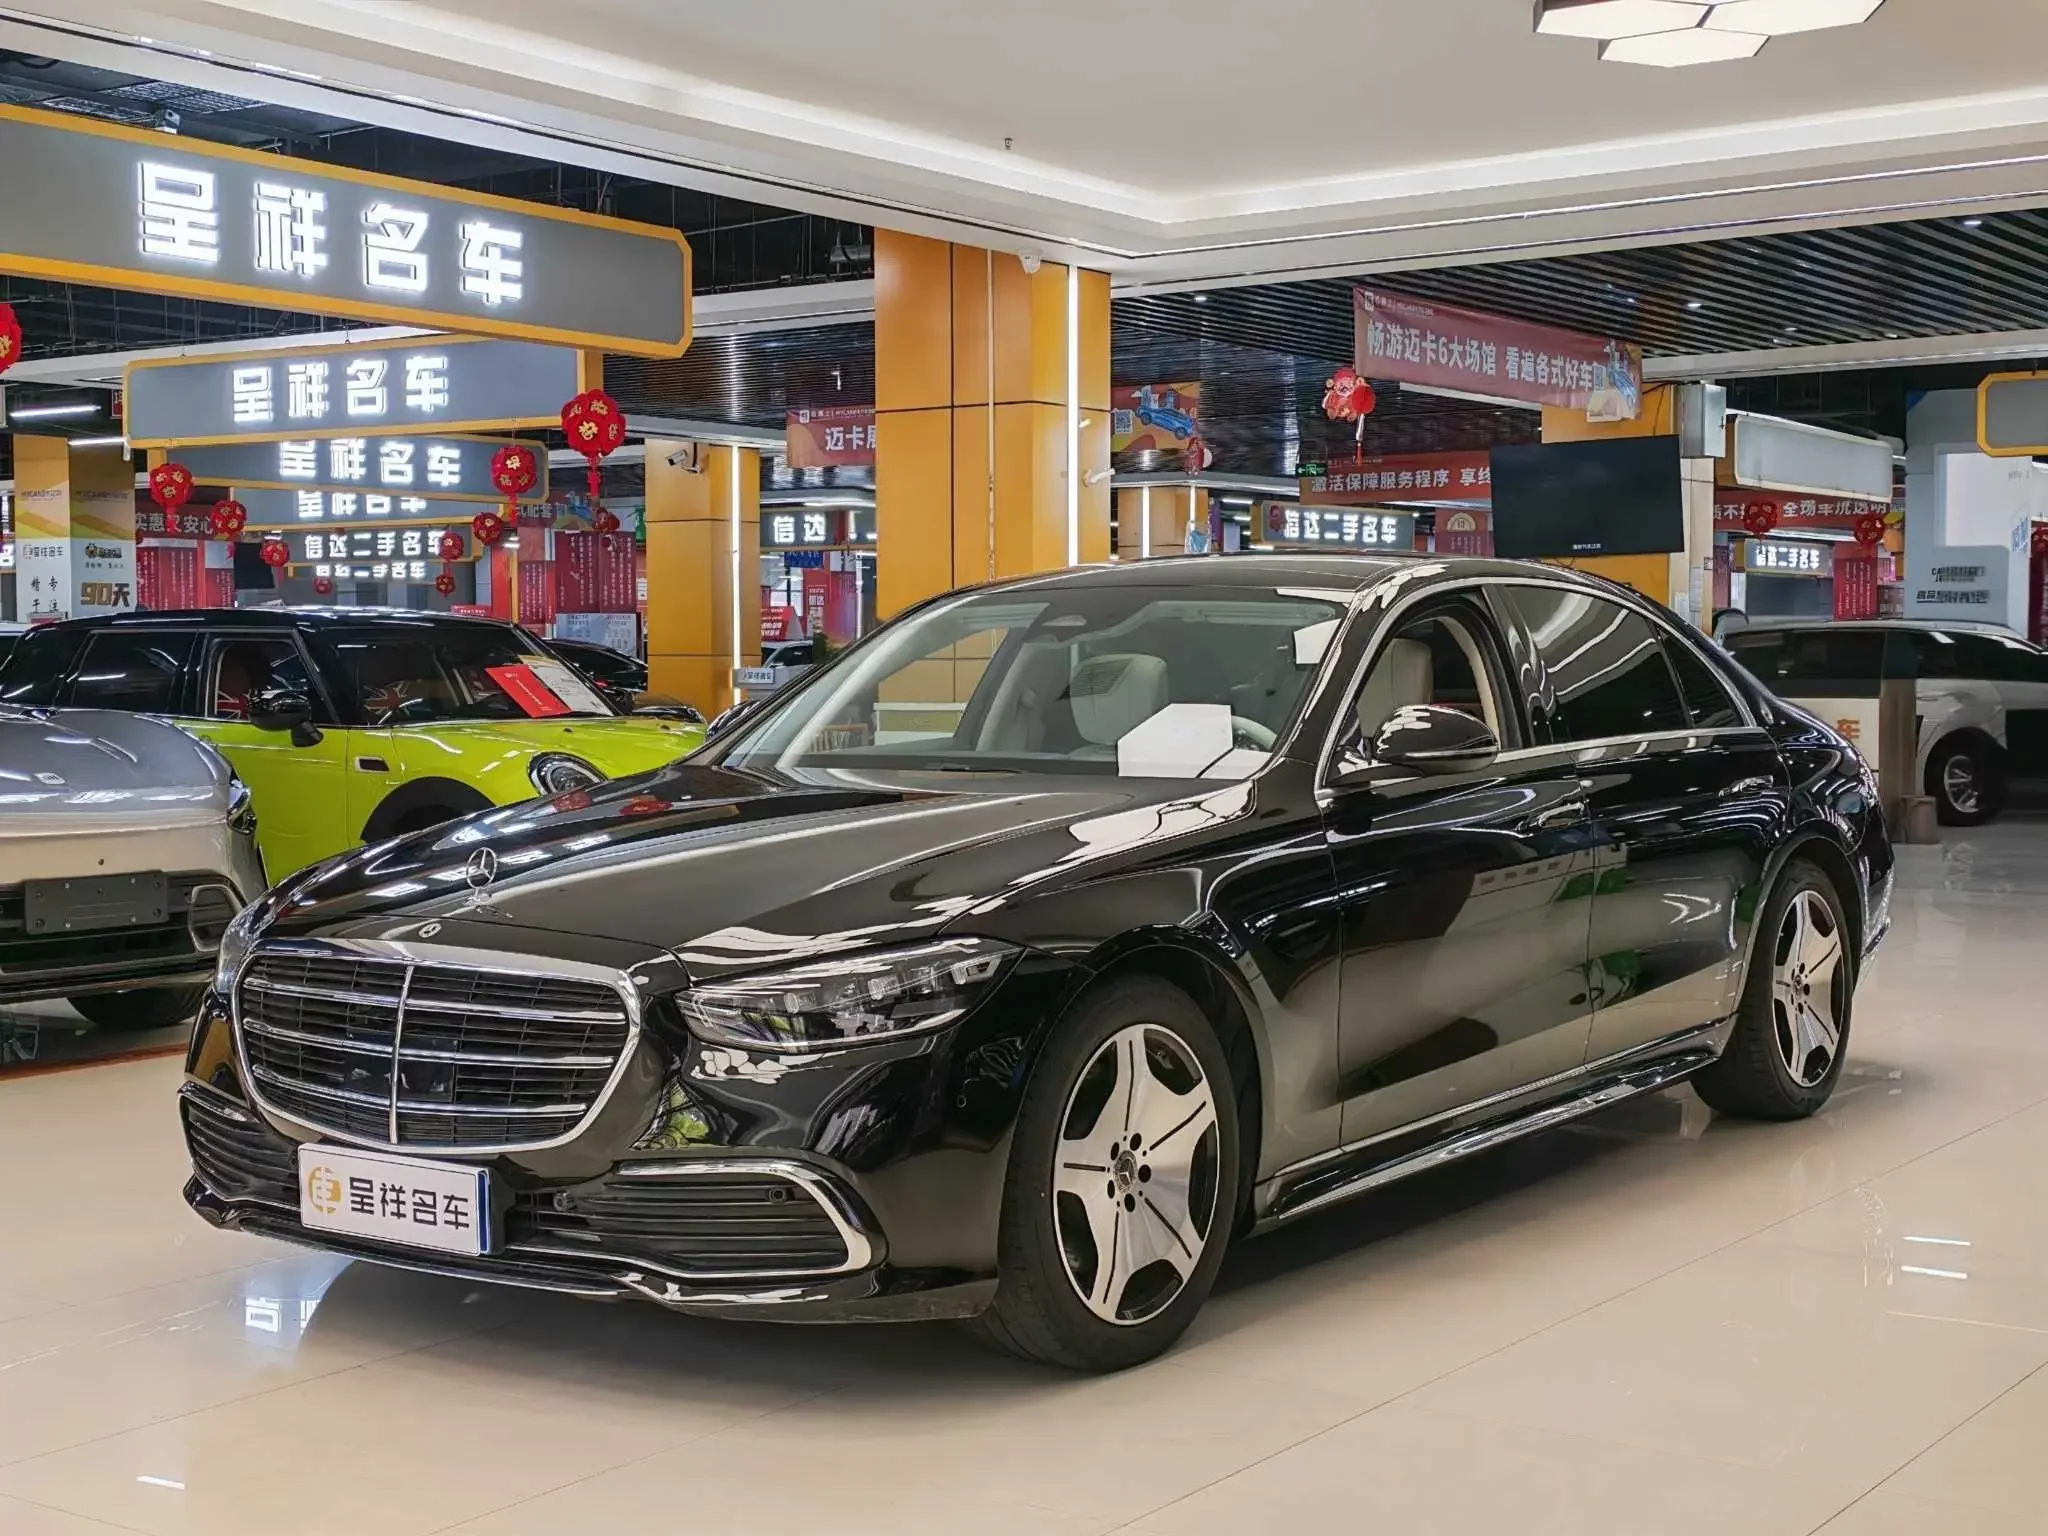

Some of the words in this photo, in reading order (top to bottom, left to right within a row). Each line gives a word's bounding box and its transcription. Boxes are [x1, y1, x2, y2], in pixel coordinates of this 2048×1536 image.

[138, 161, 525, 303] 呈祥名车
[1368, 319, 1496, 377] 畅游迈卡6大场馆
[1505, 350, 1594, 391] 看遍各式好车
[232, 355, 448, 422] 呈祥名车
[280, 438, 461, 486] 呈祥名车
[1312, 469, 1449, 492] 激活保障服务程序
[1284, 510, 1397, 543] 信达二手名车
[349, 1176, 470, 1230] 呈祥名车
